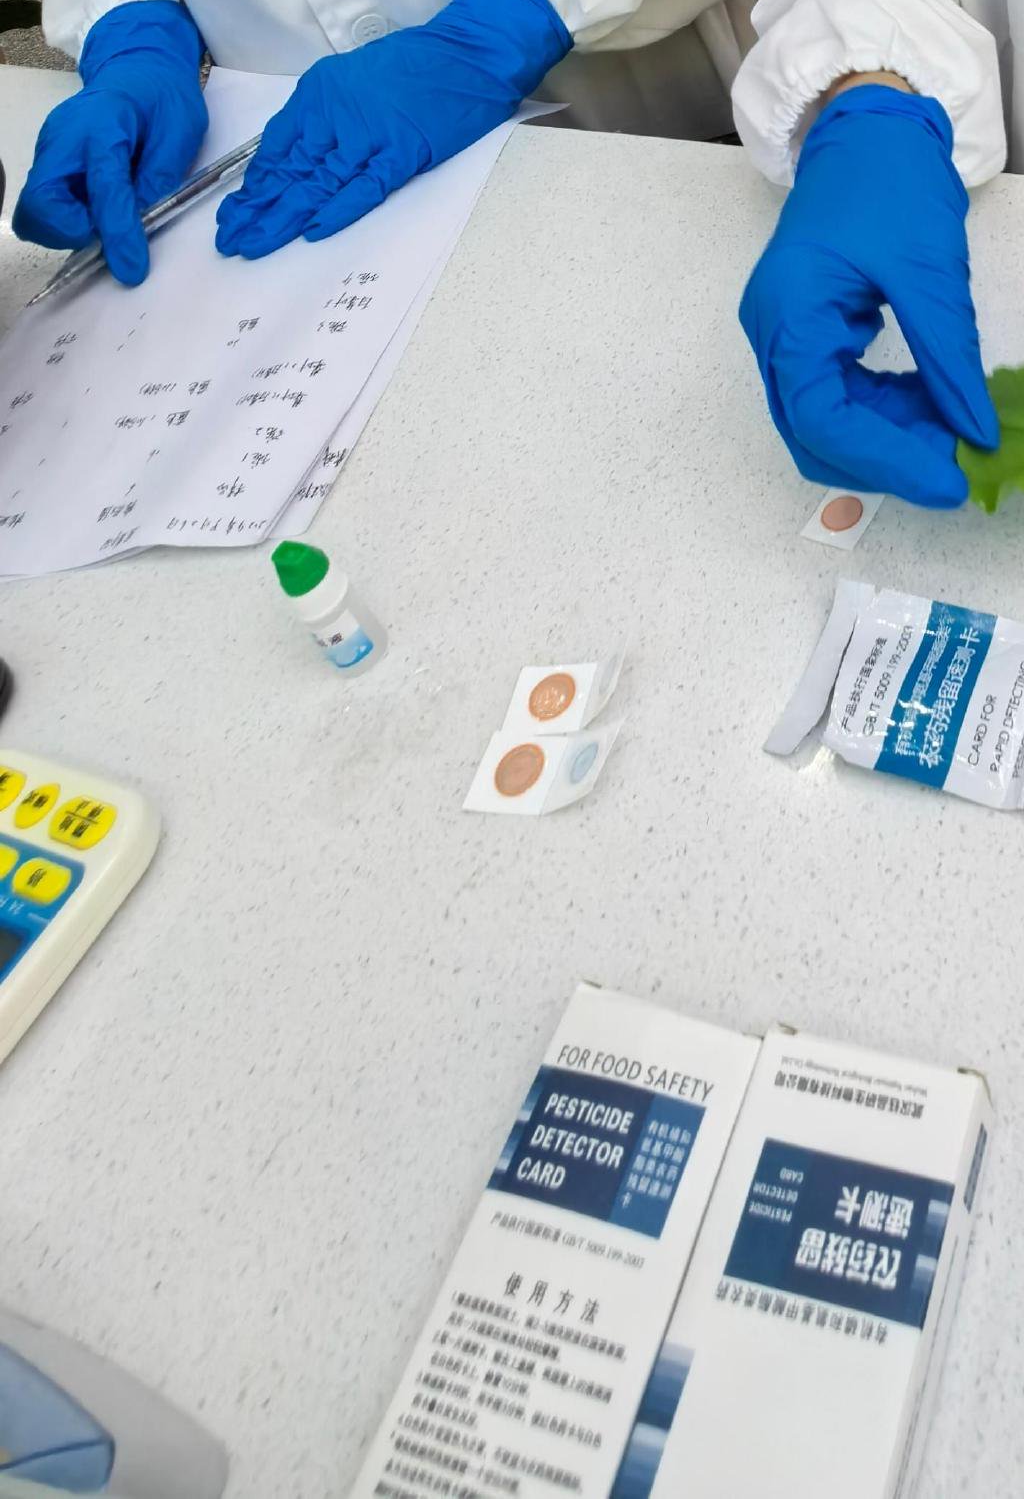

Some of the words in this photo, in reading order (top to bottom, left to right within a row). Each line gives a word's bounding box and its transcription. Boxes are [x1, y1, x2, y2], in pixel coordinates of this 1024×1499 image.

[967, 721, 988, 766] CARD
[981, 694, 997, 721] FOR
[989, 731, 1011, 772] RAPID
[556, 1045, 590, 1069] FOR
[591, 1052, 642, 1080] FOOD
[643, 1065, 715, 1102] SAFETY
[545, 1093, 634, 1134] PESTICIDE
[530, 1124, 624, 1169] DETECTOR
[516, 1157, 566, 1190] CARD
[752, 1181, 798, 1203] DETECTOR
[779, 1167, 804, 1183] CARD
[748, 1200, 793, 1223] PESTICIDE
[834, 1185, 915, 1240] 速测卡
[795, 1227, 901, 1290] 农药残留
[503, 1270, 601, 1325] 使用方法
